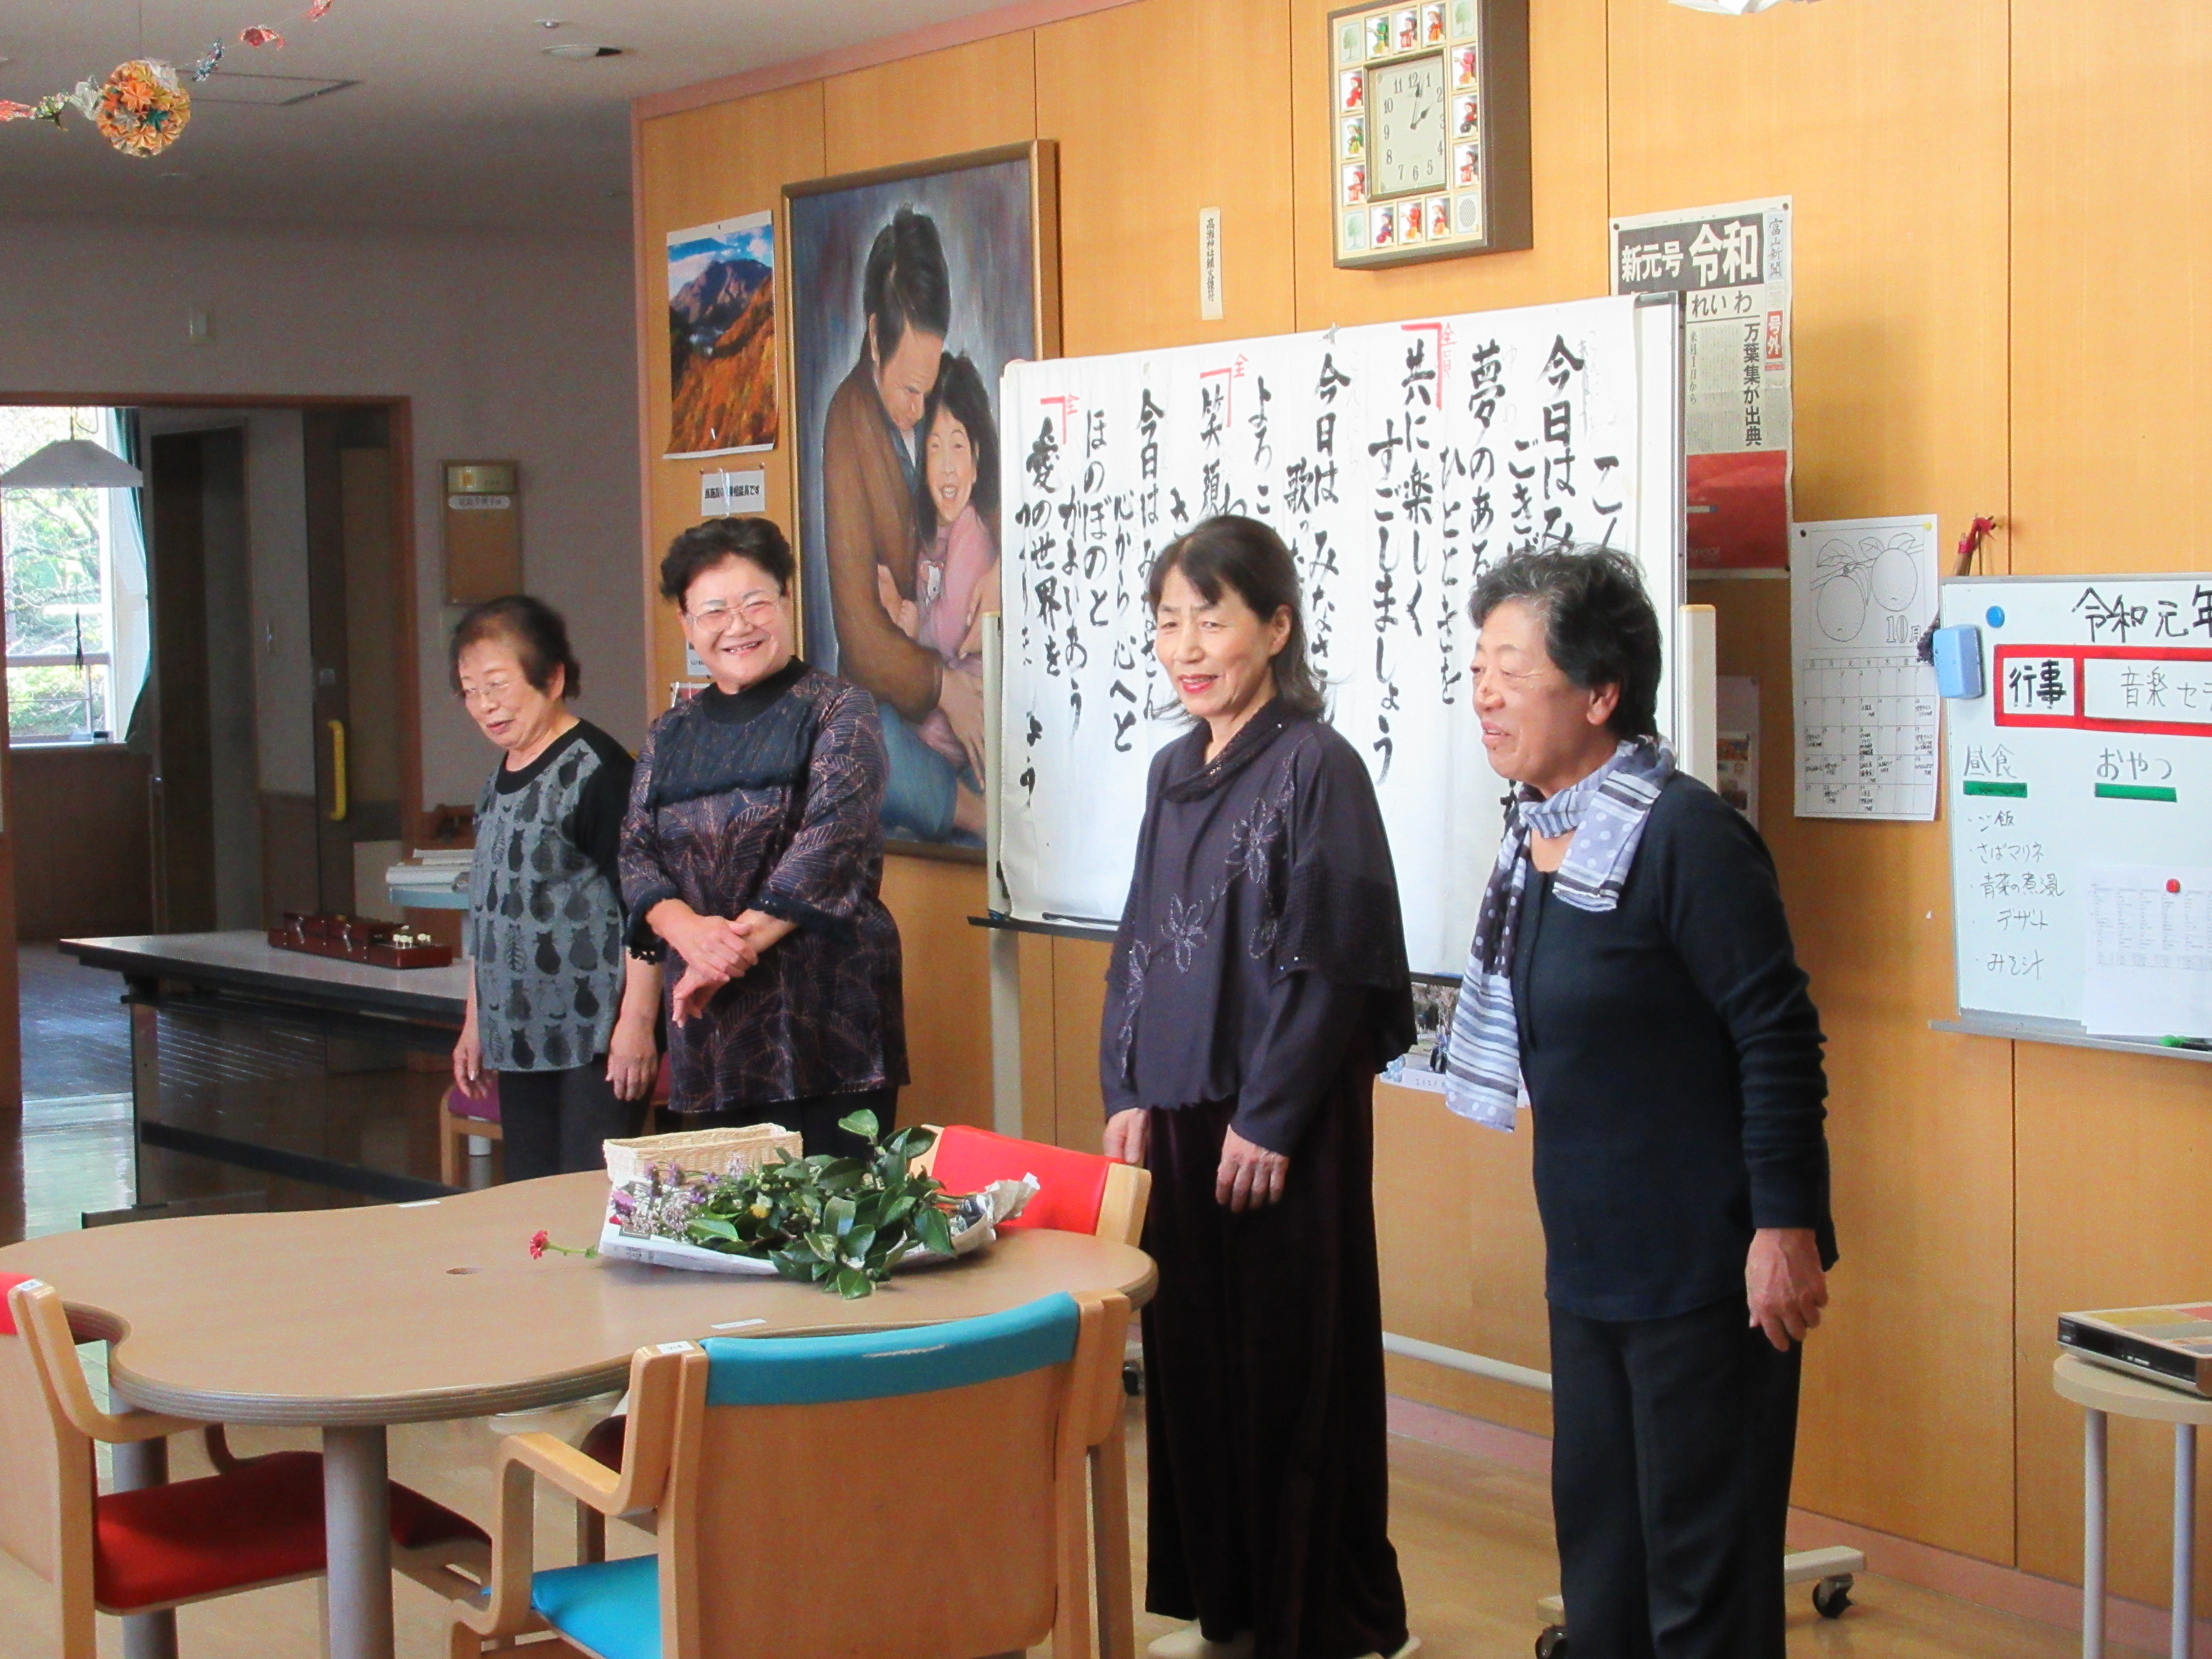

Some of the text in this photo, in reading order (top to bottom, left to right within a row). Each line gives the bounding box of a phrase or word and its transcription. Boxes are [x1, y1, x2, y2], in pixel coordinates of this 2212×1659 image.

[1394, 77, 1403, 93] 11
[1408, 72, 1418, 88] 12
[1437, 87, 1443, 102] 2
[1384, 97, 1394, 114] 10
[1384, 125, 1390, 140] 9
[1438, 140, 1443, 156] 4
[1387, 149, 1393, 165] 8
[1398, 164, 1404, 180] 7
[1413, 165, 1419, 181] 6
[1427, 159, 1433, 175] 5
[1621, 220, 1758, 287] 新元号 令和
[1768, 218, 1783, 276] 富山新聞
[1691, 290, 1752, 318] れいわ
[1768, 315, 1781, 355] 号外
[1743, 322, 1762, 446] 万葉集が出典
[1401, 339, 1436, 636] 共に楽しく
[1084, 409, 1112, 626] ほのぼのと
[1025, 416, 1062, 677] 愛の世界を
[1368, 418, 1404, 786] すごしましょう
[2072, 584, 2212, 643] 令和元年
[1886, 615, 1920, 643] 10月
[2009, 660, 2066, 709] 行事
[1964, 743, 2017, 779] 昼食
[2097, 748, 2172, 781] おやつ
[1988, 949, 2044, 981] みそ汁
